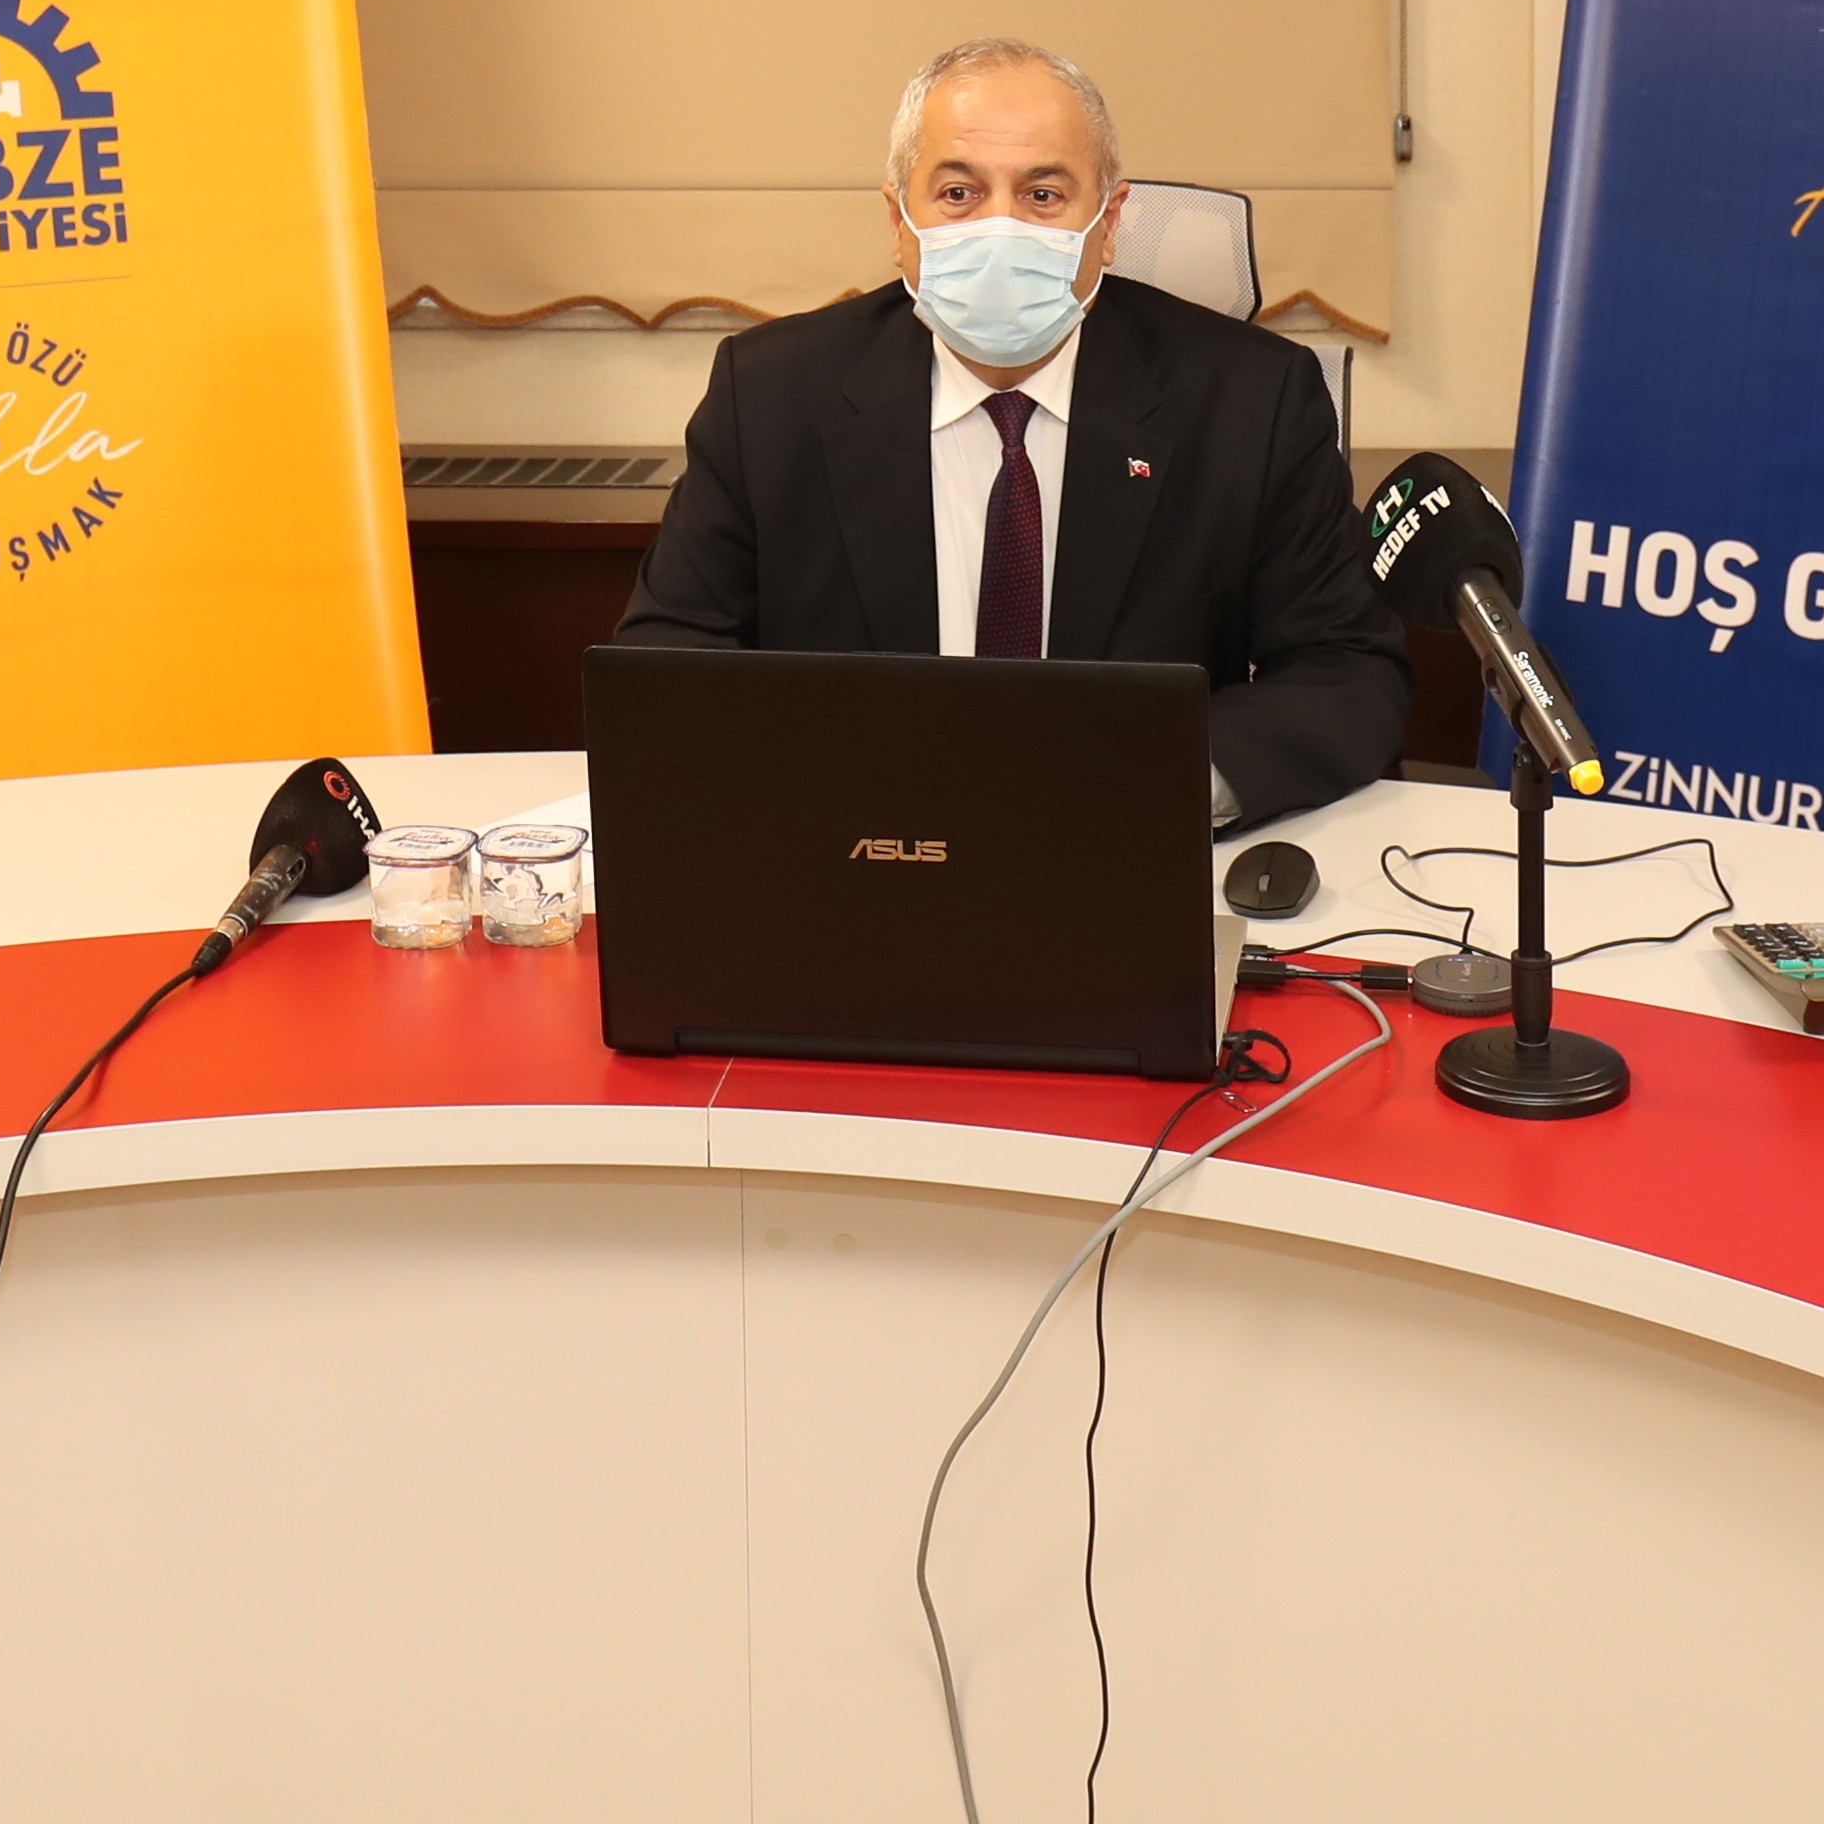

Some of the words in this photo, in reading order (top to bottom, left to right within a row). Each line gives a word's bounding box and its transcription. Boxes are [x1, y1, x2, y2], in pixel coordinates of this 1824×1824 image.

[6, 322, 88, 387] ÖZÜ
[1372, 507, 1421, 581] HEDEF
[1419, 485, 1451, 516] TV
[1565, 520, 1759, 653] HOŞ
[1513, 651, 1554, 708] Saramonic
[1608, 750, 1822, 832] ZİNNUR
[849, 838, 947, 863] ASUS
